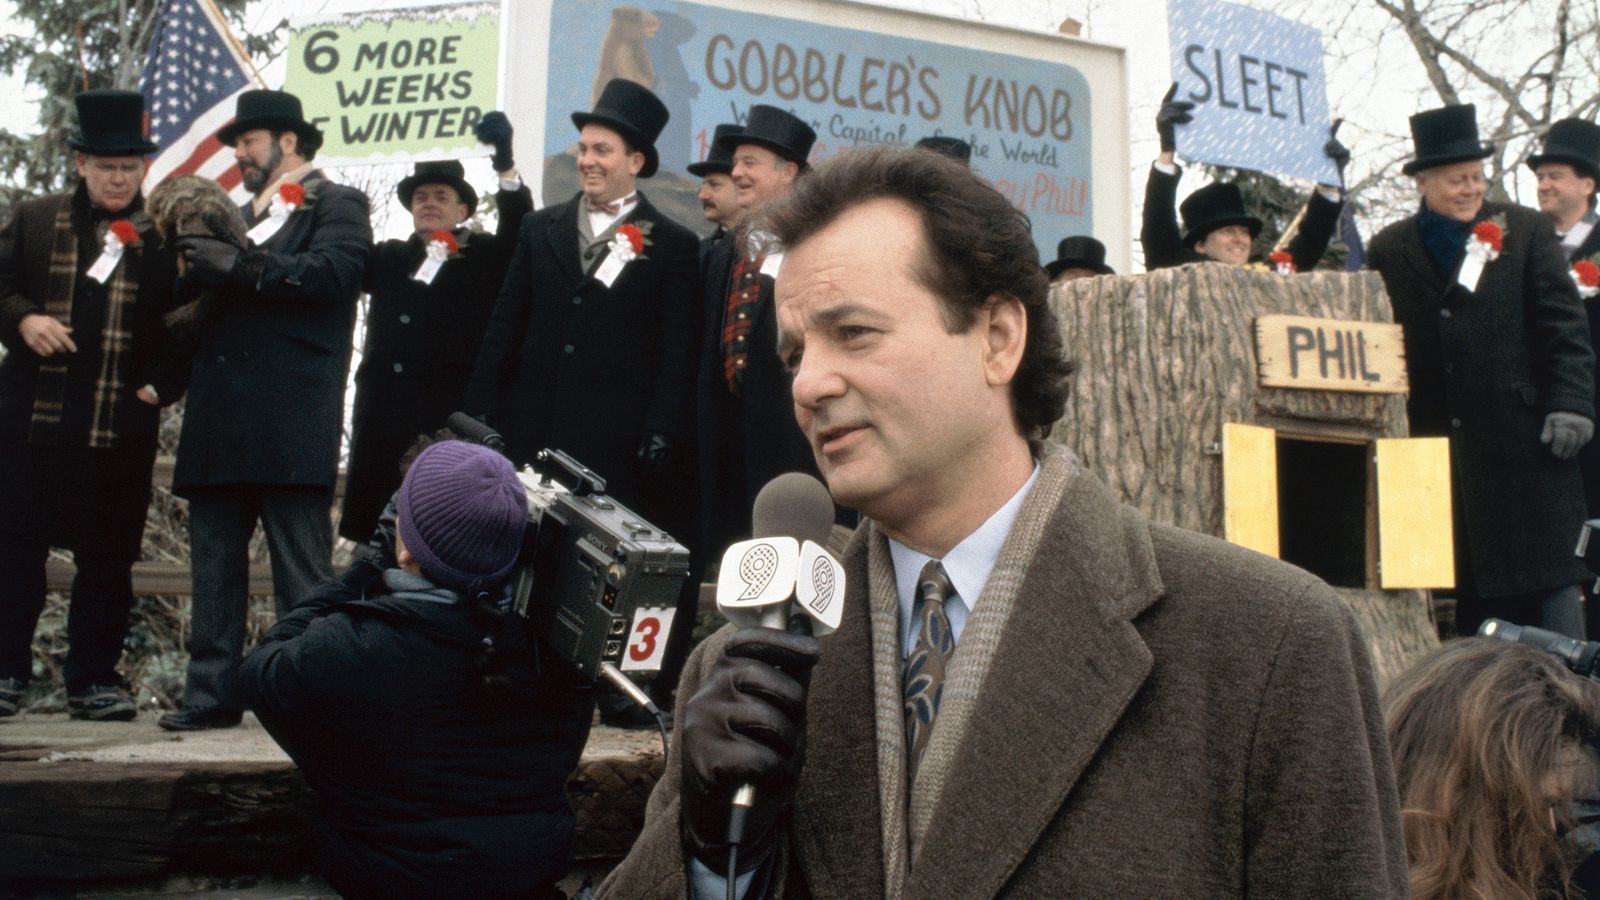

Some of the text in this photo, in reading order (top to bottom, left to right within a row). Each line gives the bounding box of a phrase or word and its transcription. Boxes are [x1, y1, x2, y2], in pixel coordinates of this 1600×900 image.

[303, 30, 462, 74] 6 MORE
[336, 70, 472, 108] WEEKS
[705, 33, 942, 120] GOBBLER'S
[963, 74, 1074, 142] KNOB
[1184, 44, 1308, 125] SLEET
[340, 105, 482, 145] WINTER
[1001, 138, 1059, 169] World
[1287, 325, 1380, 382] PHIL
[736, 543, 779, 601] 9
[809, 555, 836, 614] 9
[629, 616, 661, 662] 3
